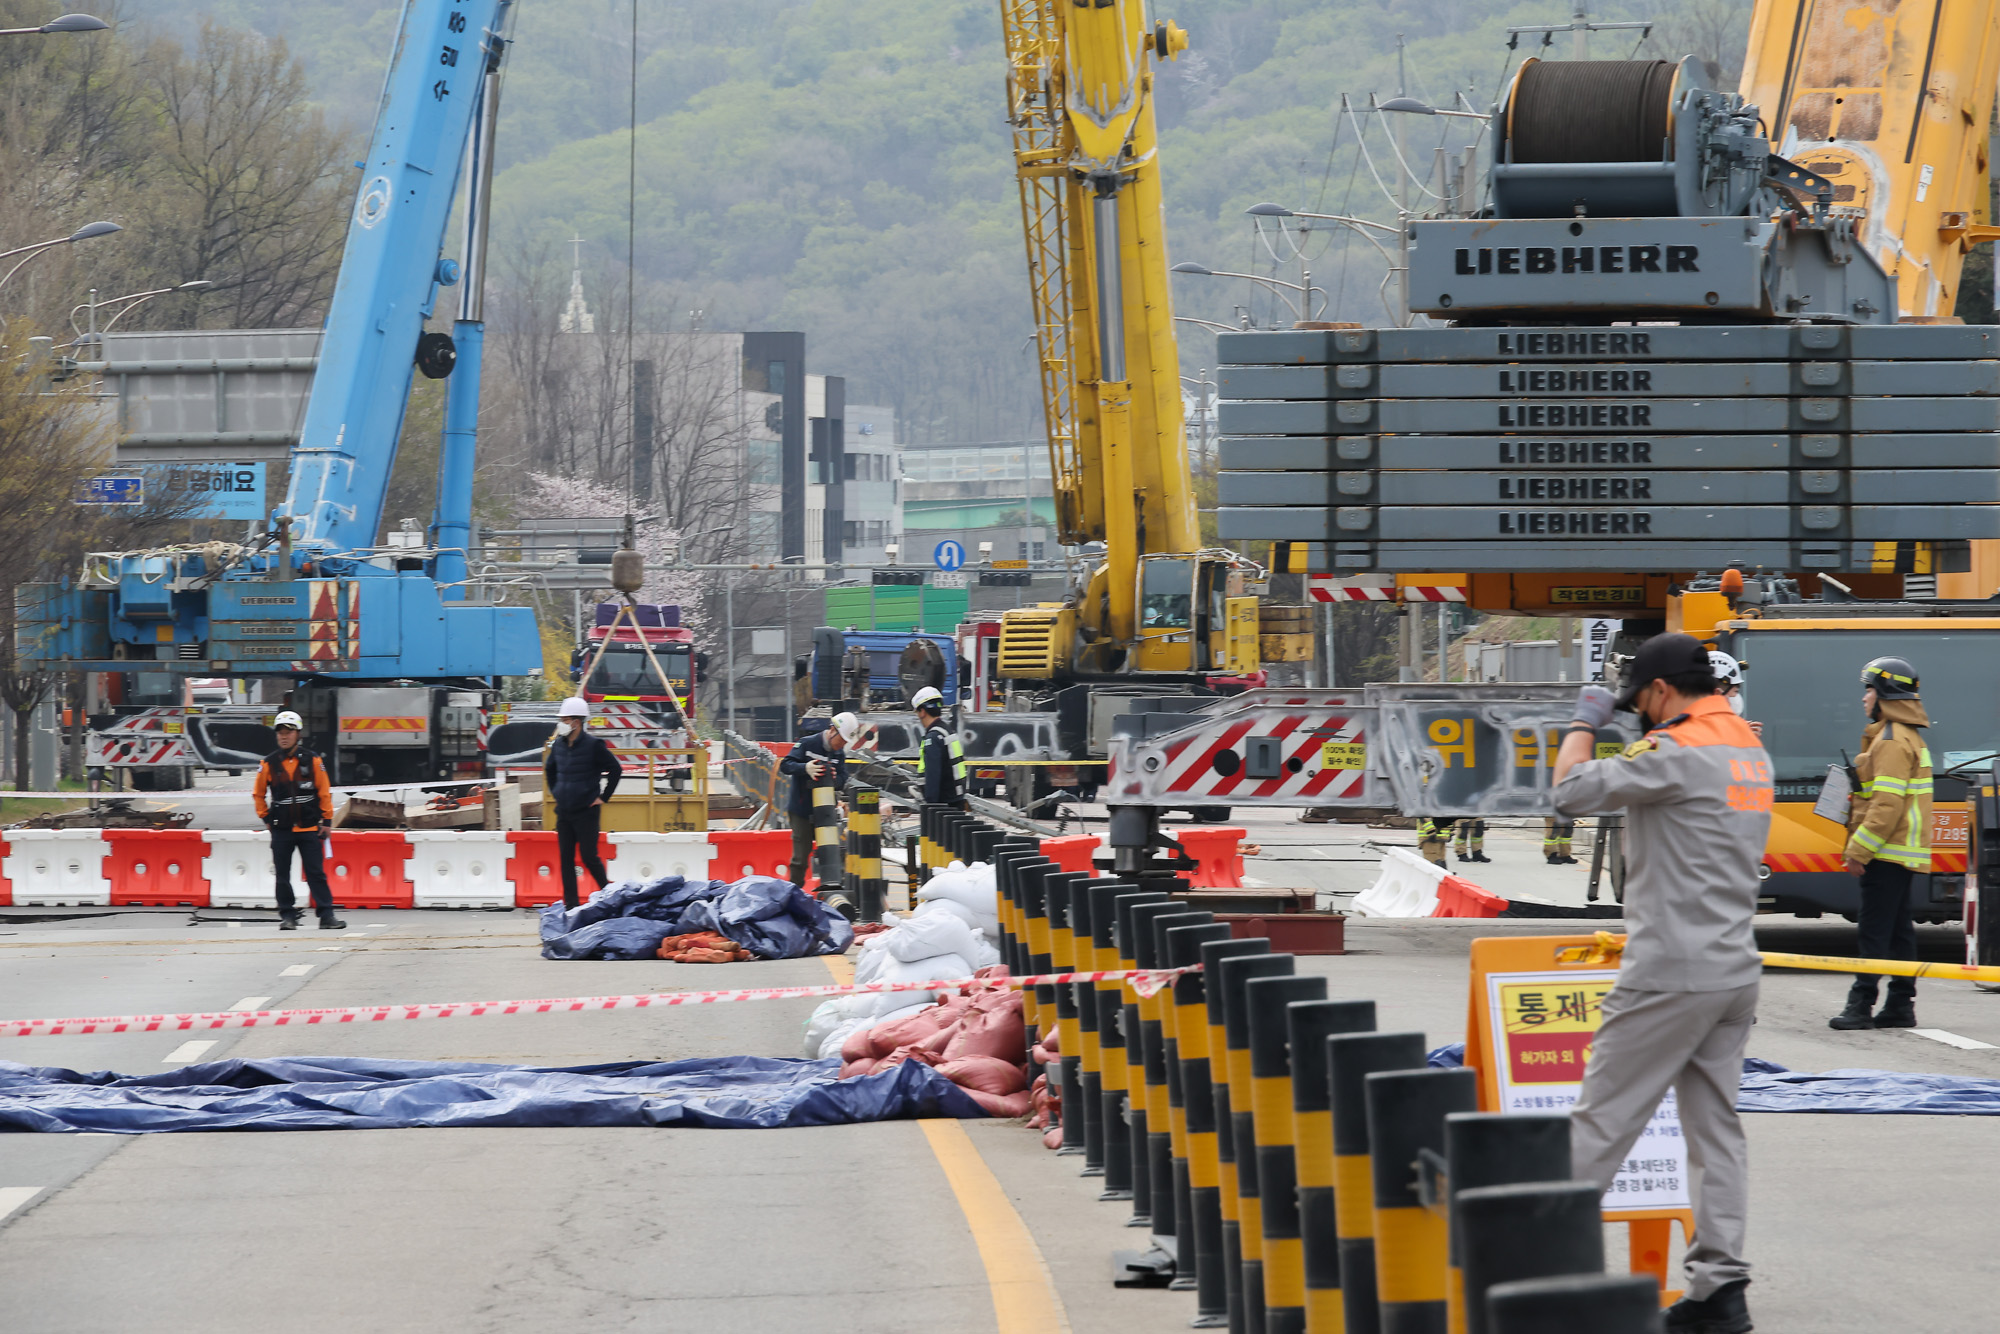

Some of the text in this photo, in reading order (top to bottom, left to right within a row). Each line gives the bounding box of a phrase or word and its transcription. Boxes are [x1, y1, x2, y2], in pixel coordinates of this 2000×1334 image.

[1455, 245, 1701, 275] LIEBHERR
[1499, 334, 1652, 355] LIEBHERR
[1499, 371, 1652, 392] LIEBHERR
[1499, 406, 1652, 427] LIEBHERR
[1499, 442, 1652, 463] LIEBHERR
[1499, 478, 1652, 499] LIEBHERR
[1499, 513, 1652, 534] LIEBHERR
[241, 597, 295, 605] LIEBHERR
[1558, 590, 1640, 601] 작업반경내
[1520, 1050, 1575, 1065] 허가자 외
